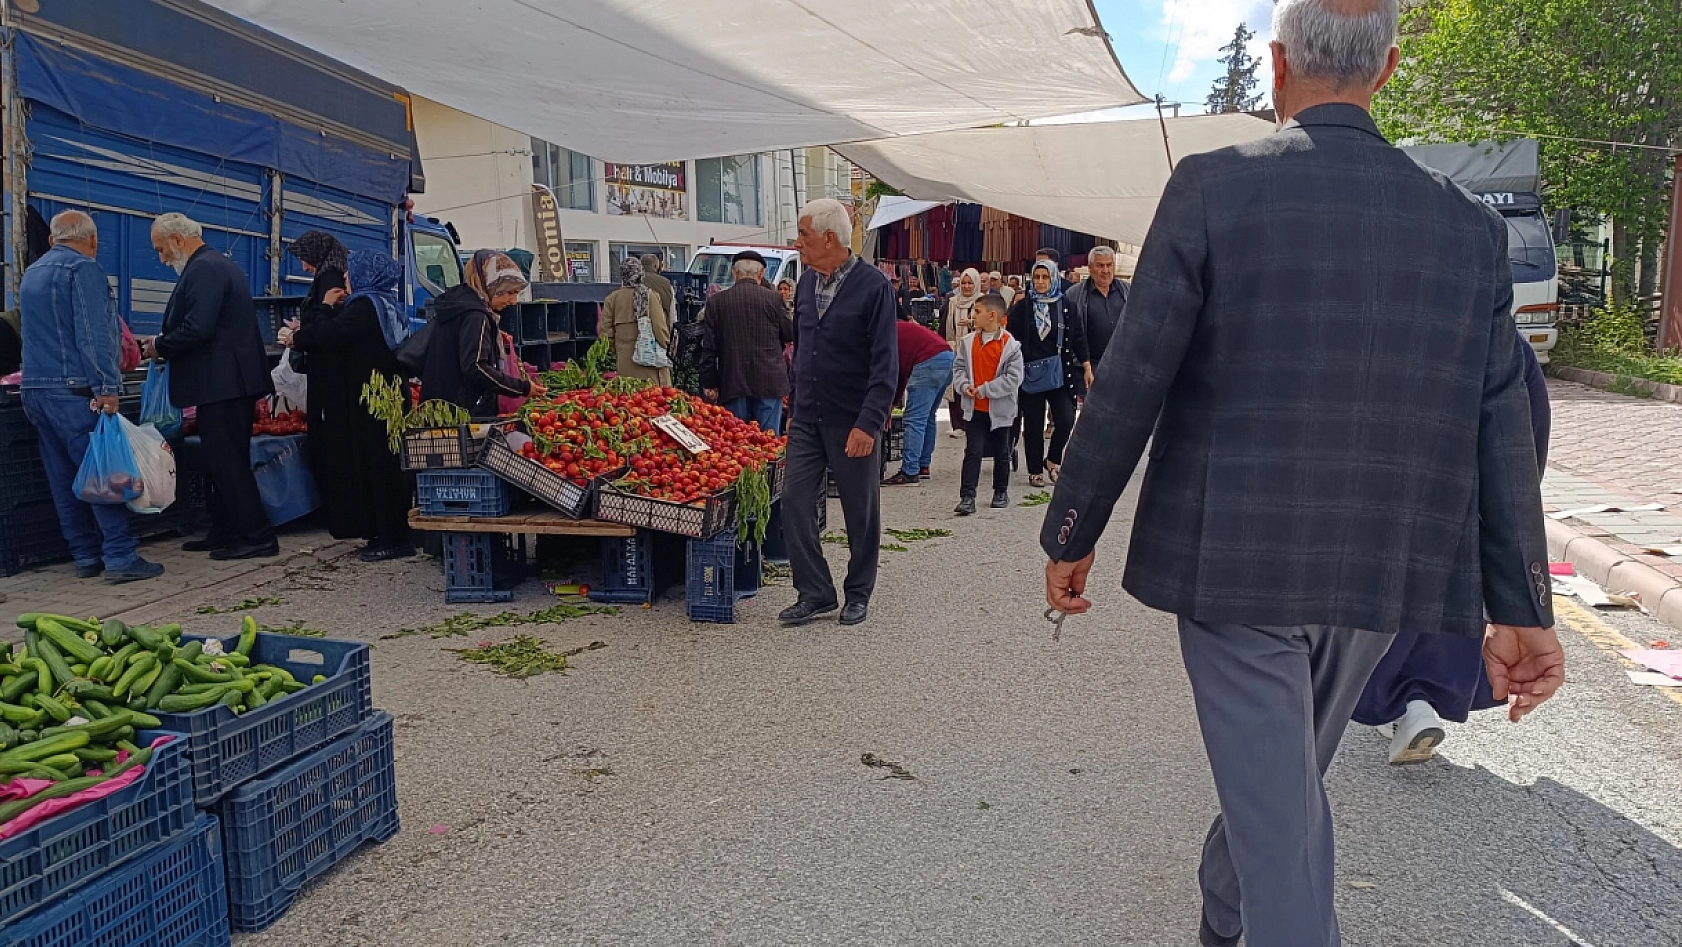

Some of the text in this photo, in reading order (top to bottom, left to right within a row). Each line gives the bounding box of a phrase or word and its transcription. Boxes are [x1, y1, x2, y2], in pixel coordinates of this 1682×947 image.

[633, 166, 642, 181] &
[643, 166, 678, 188] Mobilya
[537, 195, 565, 283] comia
